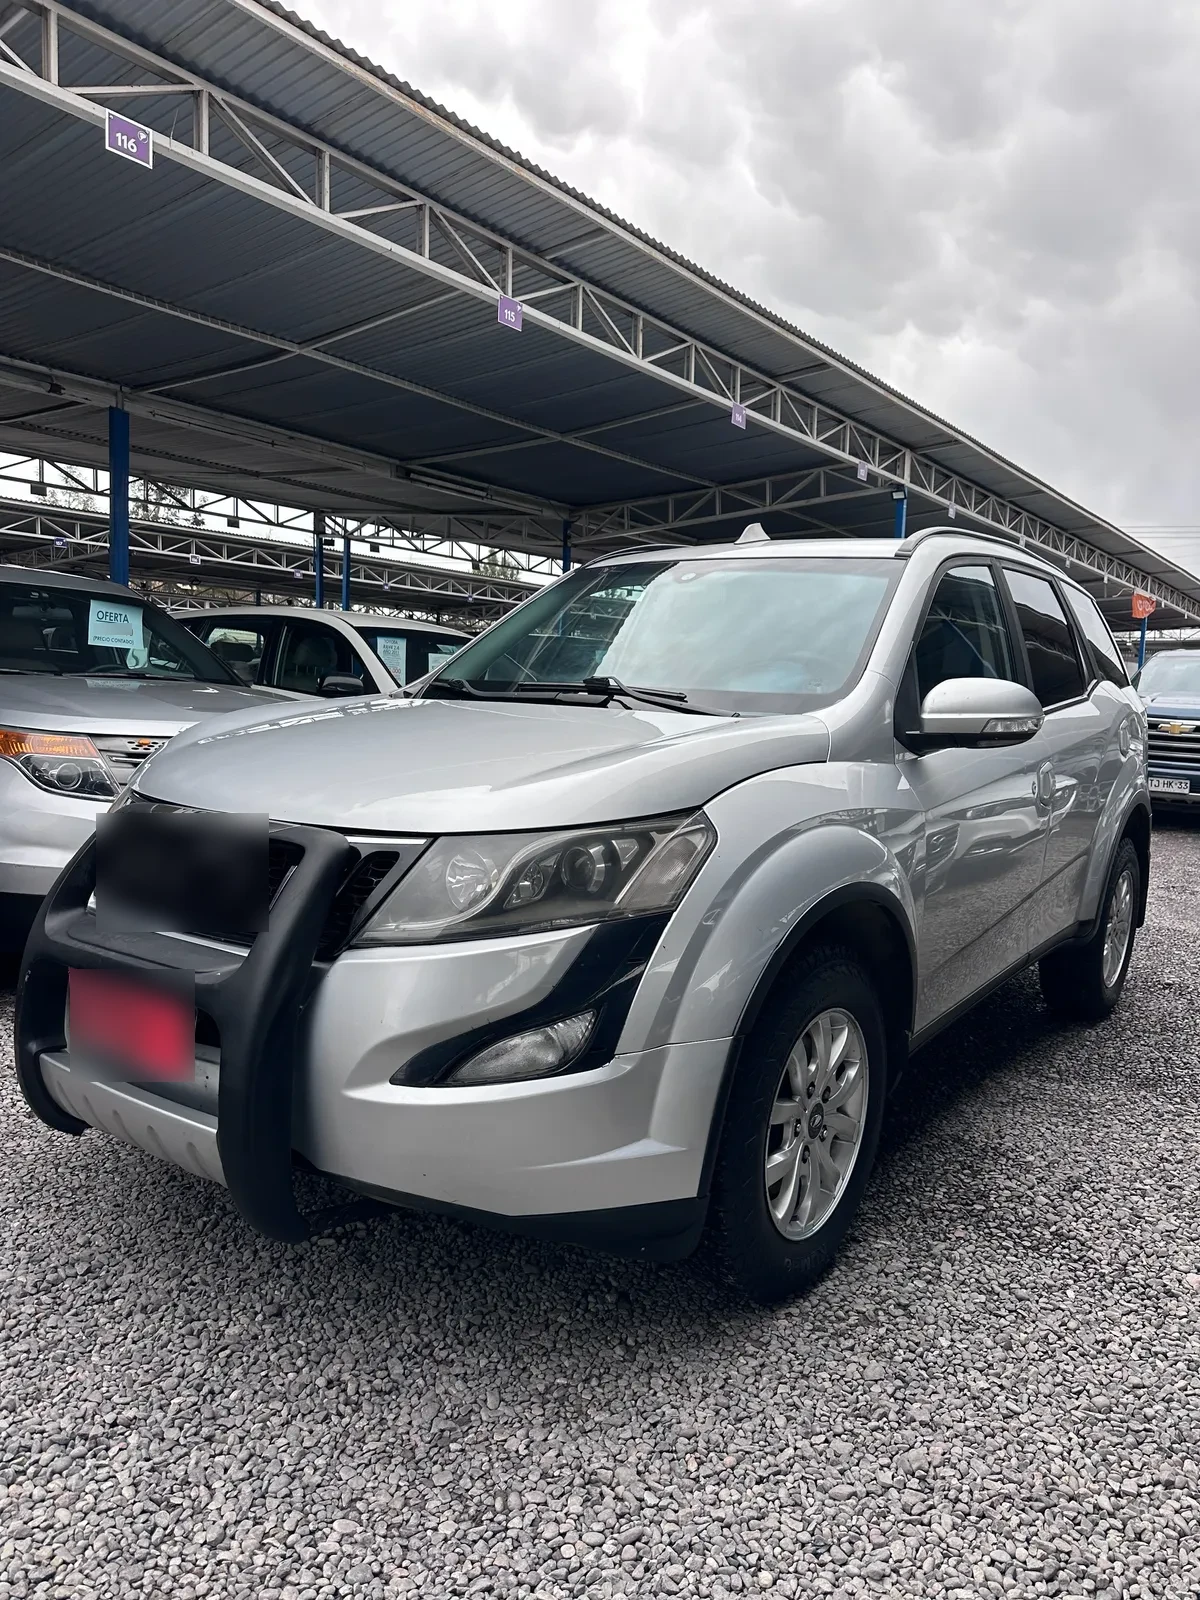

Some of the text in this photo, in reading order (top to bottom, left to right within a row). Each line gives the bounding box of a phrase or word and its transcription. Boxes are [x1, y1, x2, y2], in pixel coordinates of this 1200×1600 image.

[115, 132, 138, 153] 116
[504, 308, 516, 323] 115
[96, 610, 130, 624] OFERTA
[92, 635, 135, 646] (PRECIO CONTADO)
[1150, 779, 1160, 788] TJ
